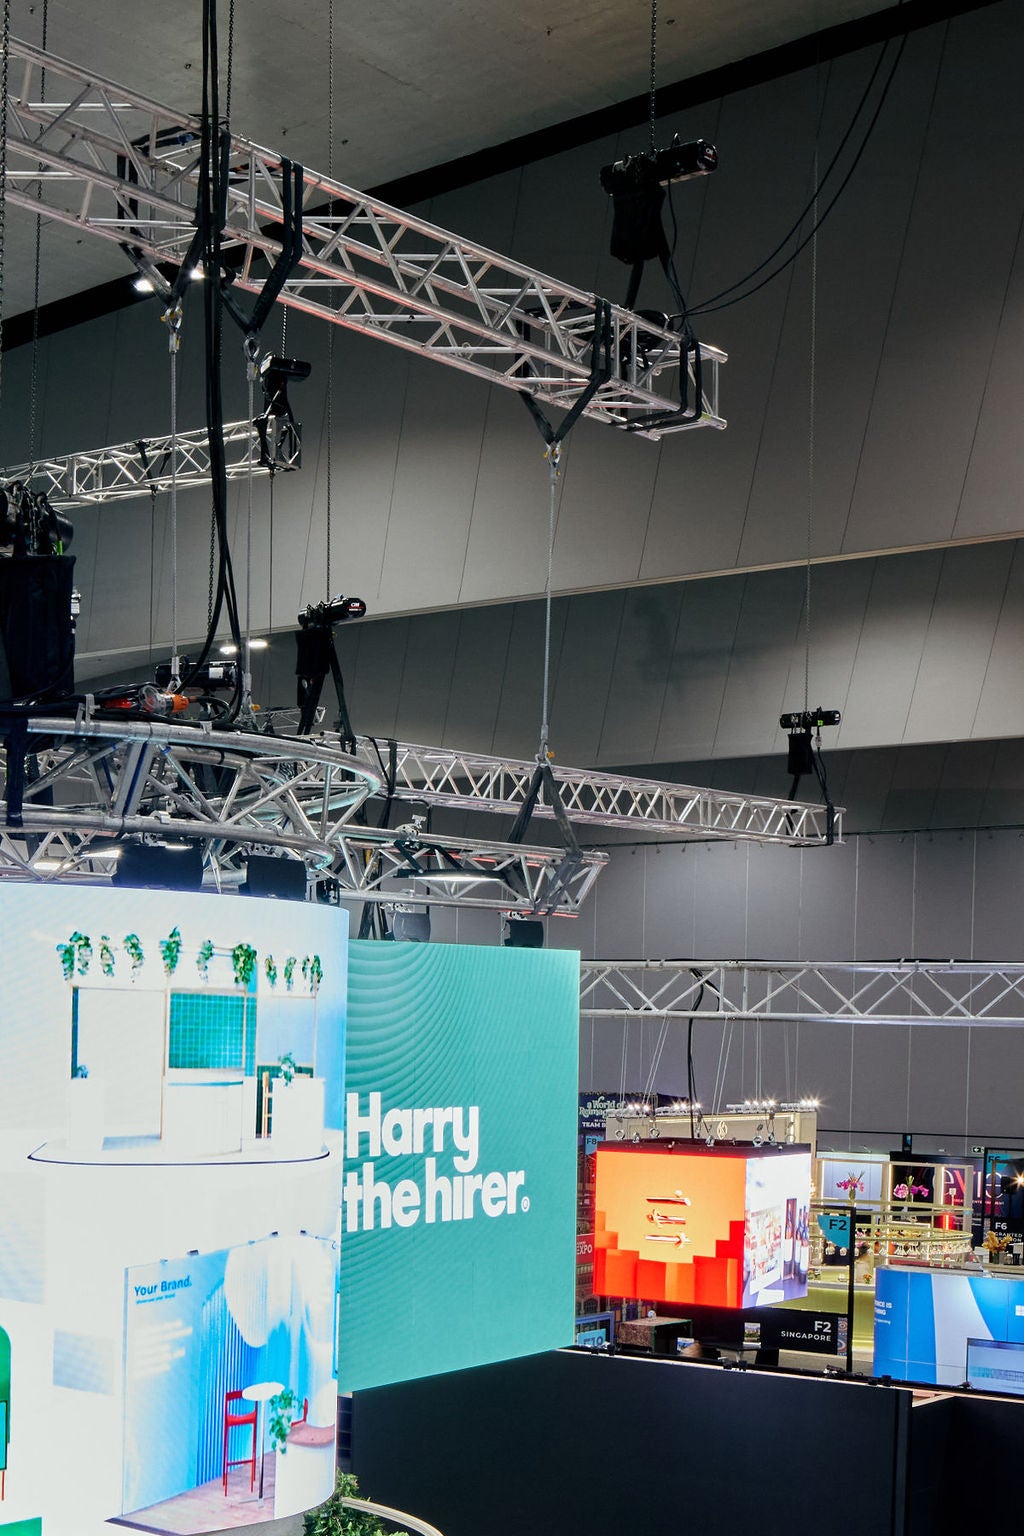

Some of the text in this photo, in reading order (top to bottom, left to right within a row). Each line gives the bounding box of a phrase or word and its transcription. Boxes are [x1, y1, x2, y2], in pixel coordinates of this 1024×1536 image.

[346, 1091, 479, 1173] Harry
[343, 1161, 421, 1233] the
[829, 1218, 847, 1231] F2
[995, 1222, 1008, 1230] F6
[134, 1284, 158, 1296] Your
[814, 1320, 832, 1333] F2
[781, 1330, 832, 1342] SINGAPORE
